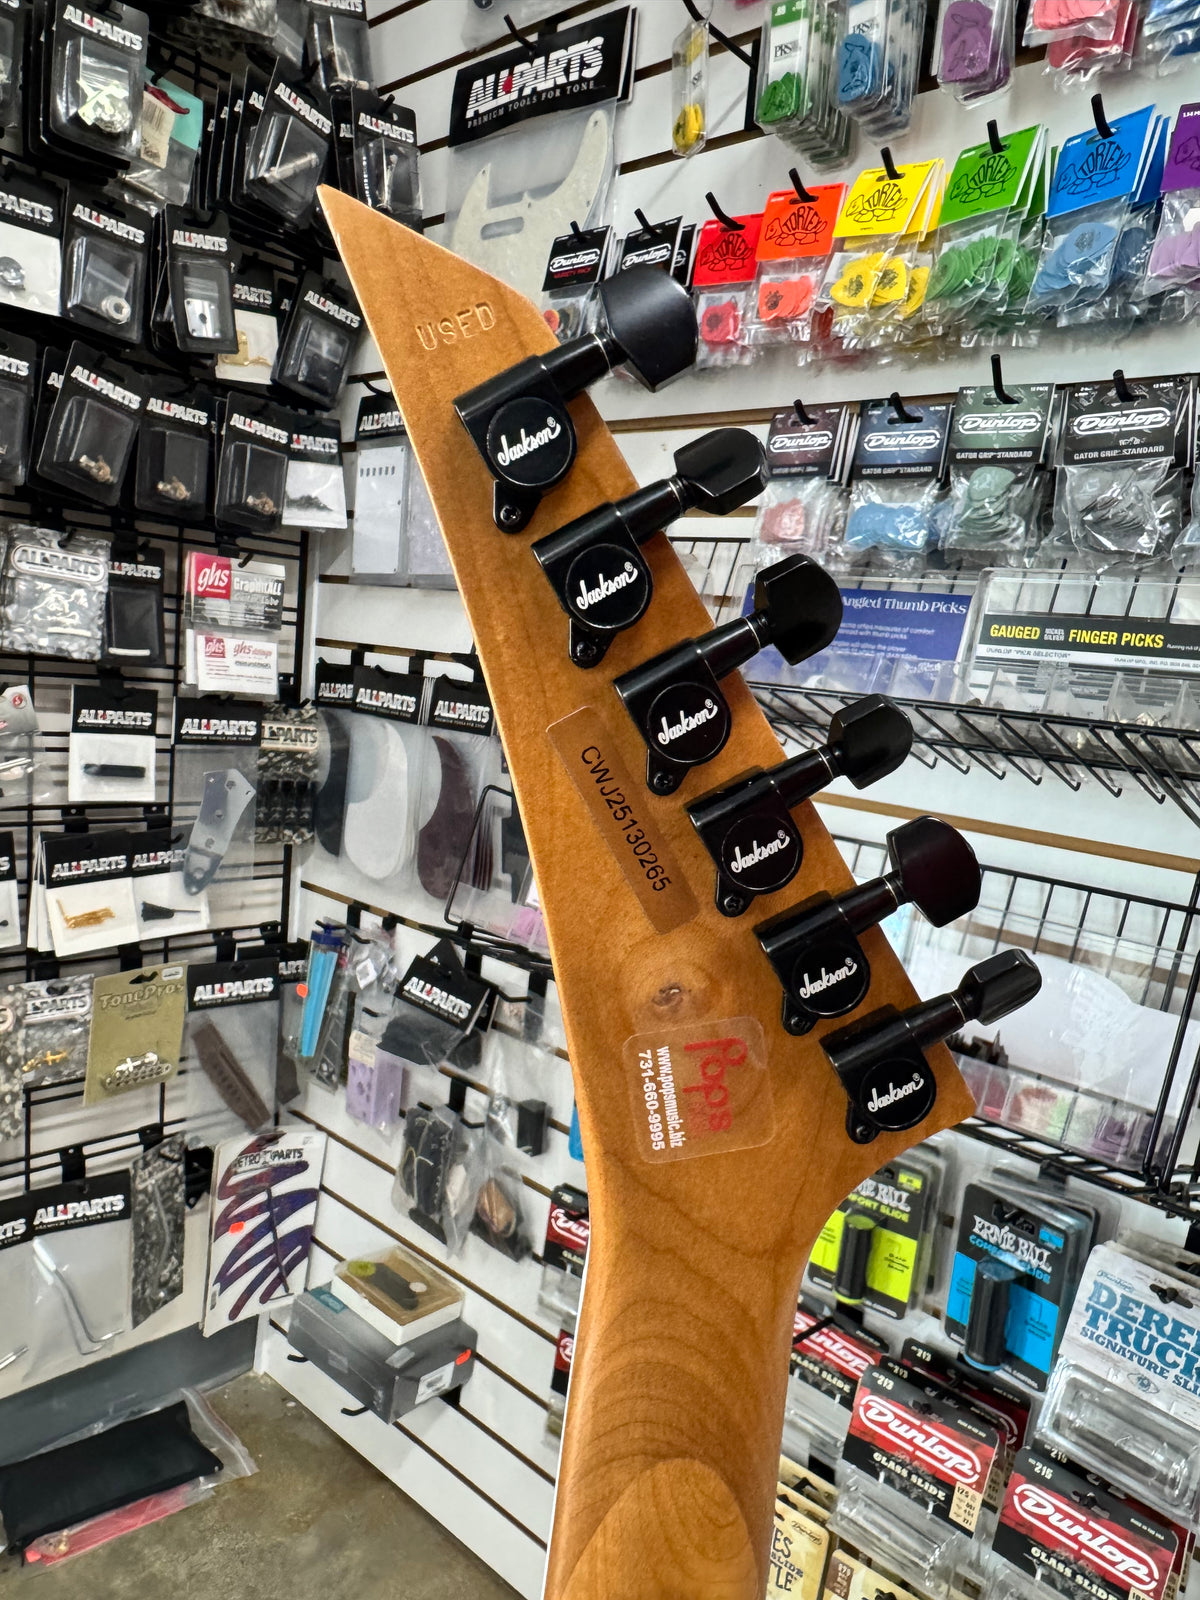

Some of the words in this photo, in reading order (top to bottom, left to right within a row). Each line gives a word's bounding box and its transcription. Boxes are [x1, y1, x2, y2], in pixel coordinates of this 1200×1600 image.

[63, 5, 142, 50] ALLPARTS
[465, 36, 605, 119] ALLPARTS
[274, 82, 332, 134] ALLPARTS
[467, 107, 505, 129] PREMIUM
[508, 96, 538, 112] TOOLS
[541, 90, 561, 102] FOR
[566, 80, 595, 95] TONE
[358, 112, 414, 143] ALLPARTS
[0, 191, 54, 222] PARTS
[73, 203, 145, 244] ALLPARTS
[172, 229, 228, 252] ALLPARTS
[551, 252, 599, 269] Dunlop
[624, 248, 670, 266] Dunlop
[232, 283, 272, 305] PARTS
[304, 290, 361, 328] ALLPARTS
[415, 301, 497, 351] USED
[71, 365, 142, 410] ALLPARTS
[147, 397, 208, 426] ALLPARTS
[359, 411, 404, 432] ALLPAR
[963, 415, 1038, 429] Dunlop
[1080, 410, 1168, 430] Dunlop
[230, 413, 289, 444] ALLPARTS
[774, 435, 830, 449] Dunlop
[868, 432, 937, 447] Dunlop
[955, 451, 978, 460] GATOR
[997, 450, 1033, 459] STANDARD
[1073, 451, 1099, 461] GATOR
[1121, 445, 1165, 456] STANDARD
[108, 560, 161, 580] LLPARTS
[197, 562, 230, 593] ghs
[842, 595, 881, 609] Angled
[884, 598, 929, 612] Thumb
[930, 601, 967, 615] Picks
[990, 624, 1041, 640] GAUGED
[1068, 629, 1118, 645] FINGER
[1120, 632, 1165, 648] PICKS
[356, 688, 416, 713] ALLPARTS
[434, 701, 490, 724] ALLPARTS
[77, 709, 153, 727] ALLPARTS
[180, 717, 257, 736] ALLPARTS
[581, 746, 672, 892] CWJ25130265
[51, 855, 127, 878] ALLPARTS
[132, 850, 185, 869] ALLPAR
[101, 983, 184, 1009] TonePros
[194, 977, 275, 1001] ALLPARTS
[404, 977, 471, 1019] ALLPARTS
[638, 1049, 665, 1151] 731-660-9995
[656, 1045, 687, 1148] www.popsmusic.biz
[272, 1148, 303, 1160] PARTS
[34, 1194, 125, 1225] ALLPARTS
[876, 1183, 911, 1212] BALL
[879, 1206, 910, 1223] SLIDE
[973, 1215, 1016, 1252] ERNIE
[1016, 1237, 1053, 1273] BALL
[1088, 1280, 1200, 1352] DERE
[1085, 1303, 1200, 1385] TRUCK
[790, 1352, 820, 1374] GLASS
[821, 1367, 851, 1393] SLIDE
[1080, 1326, 1170, 1379] SIGNATURE
[1172, 1373, 1200, 1397] SLI
[865, 1401, 975, 1477] Dunlop
[872, 1452, 908, 1478] GLASS
[910, 1471, 946, 1501] SLIDE
[1021, 1490, 1151, 1582] Dunlop
[1030, 1546, 1072, 1578] GLASS
[1074, 1570, 1118, 1600] SLIDE
